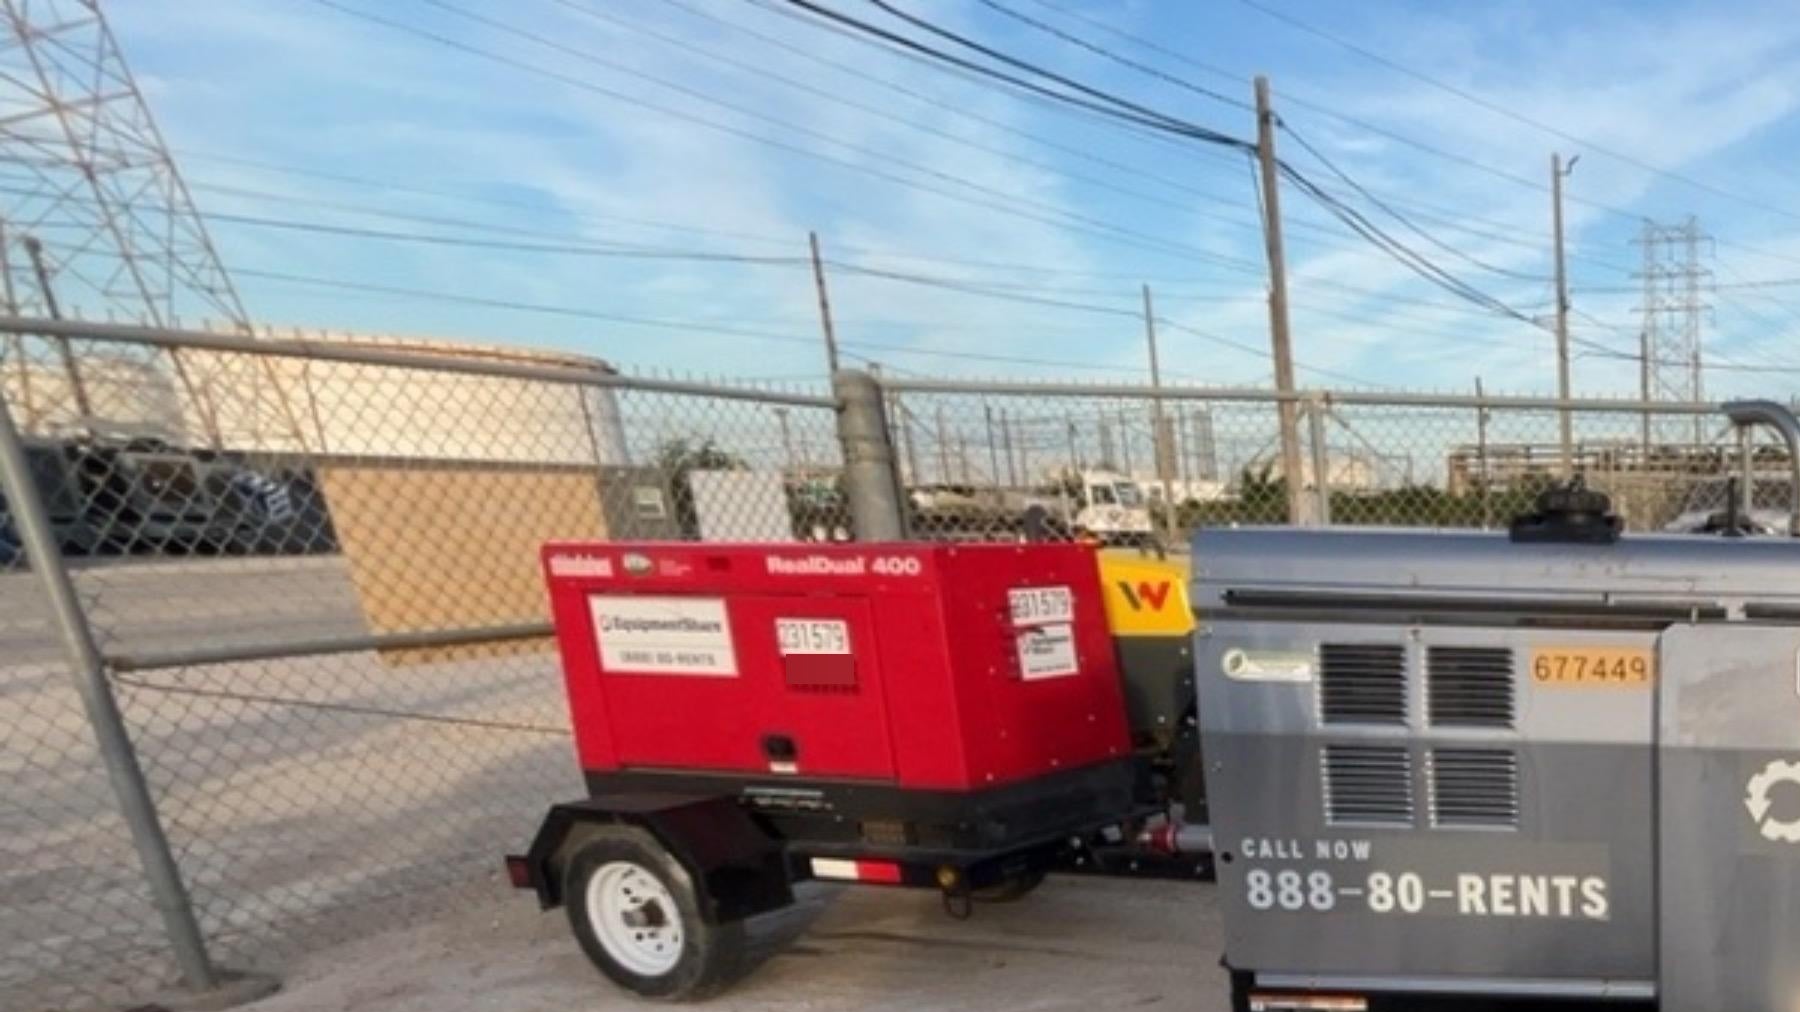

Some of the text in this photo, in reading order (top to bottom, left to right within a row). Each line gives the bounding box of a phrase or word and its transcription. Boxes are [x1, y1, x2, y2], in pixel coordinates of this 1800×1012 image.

[765, 556, 922, 576] RealDual 400
[613, 616, 721, 634] EquipmentShare
[1533, 654, 1649, 683] 677449
[1241, 839, 1372, 861] CALL NOW
[1245, 869, 1611, 918] 888-80-RENTS
